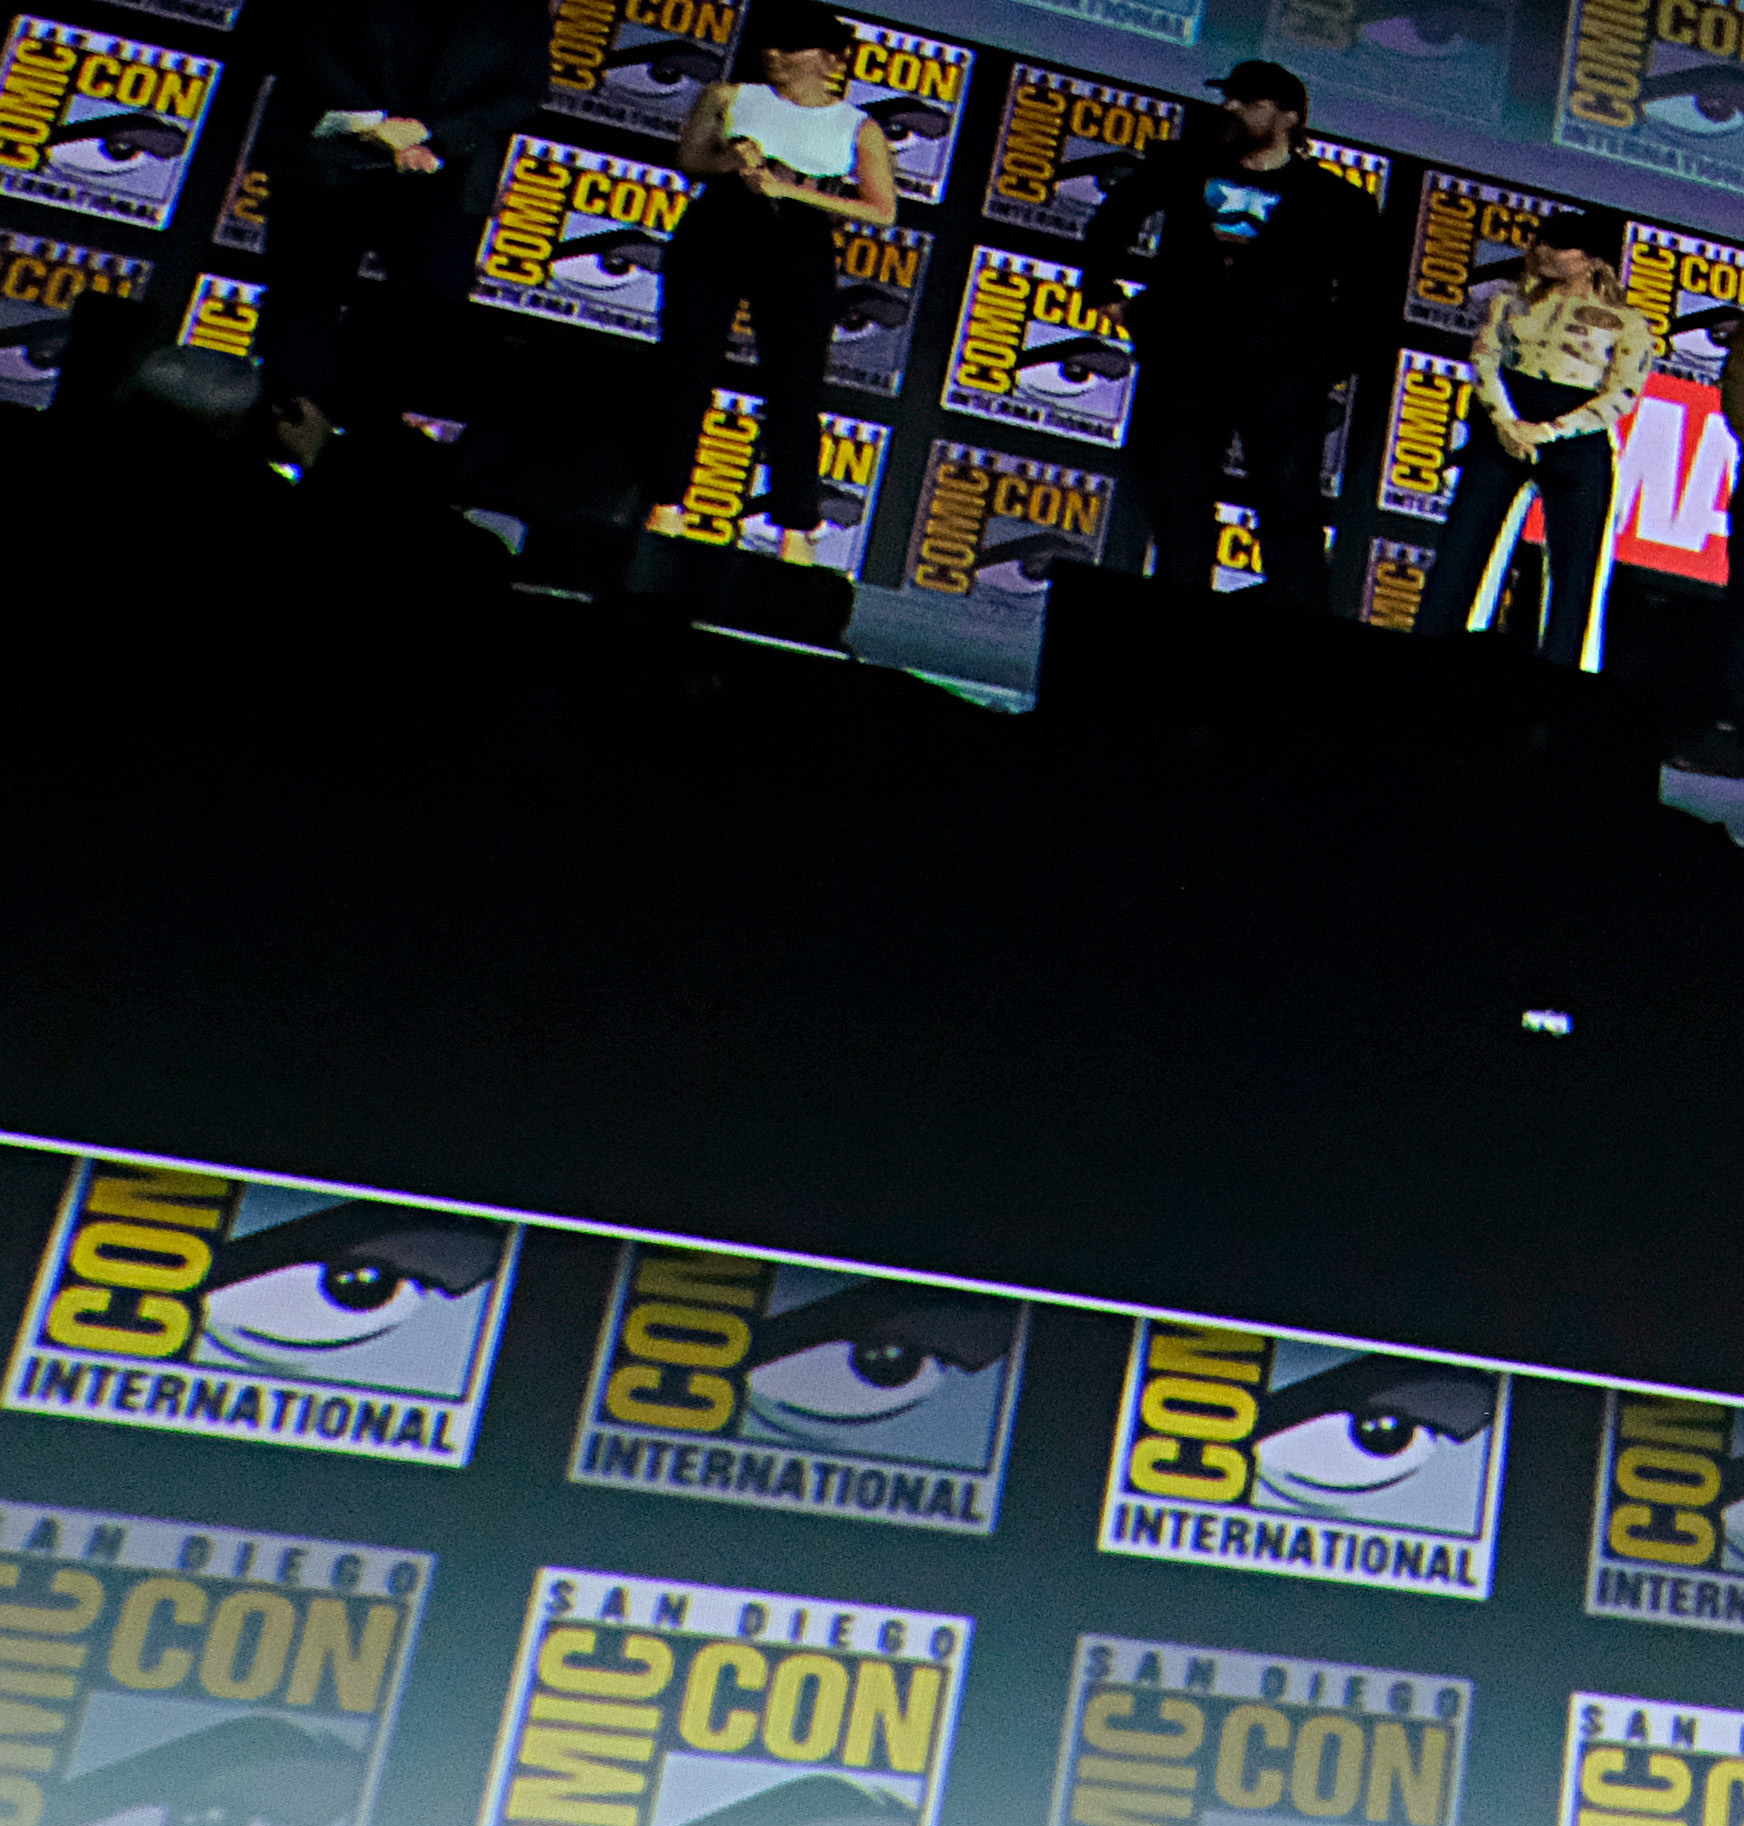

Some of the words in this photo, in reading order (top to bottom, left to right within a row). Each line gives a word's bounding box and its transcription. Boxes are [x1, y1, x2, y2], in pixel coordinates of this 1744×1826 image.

[75, 55, 201, 119] CON
[853, 40, 959, 103] CON
[486, 156, 573, 287] COMIC
[571, 169, 689, 233] CON
[957, 264, 1032, 395] COMIC
[683, 406, 760, 547] COMIC
[1390, 371, 1454, 494] COMIC
[18, 1356, 459, 1456] INTERNATIONAL
[1112, 1502, 1478, 1588] INTERNATIONAL
[546, 1580, 687, 1628] SAN
[737, 1603, 956, 1660] DIEGO
[676, 1640, 946, 1775] CON
[1581, 1704, 1696, 1747] SAN
